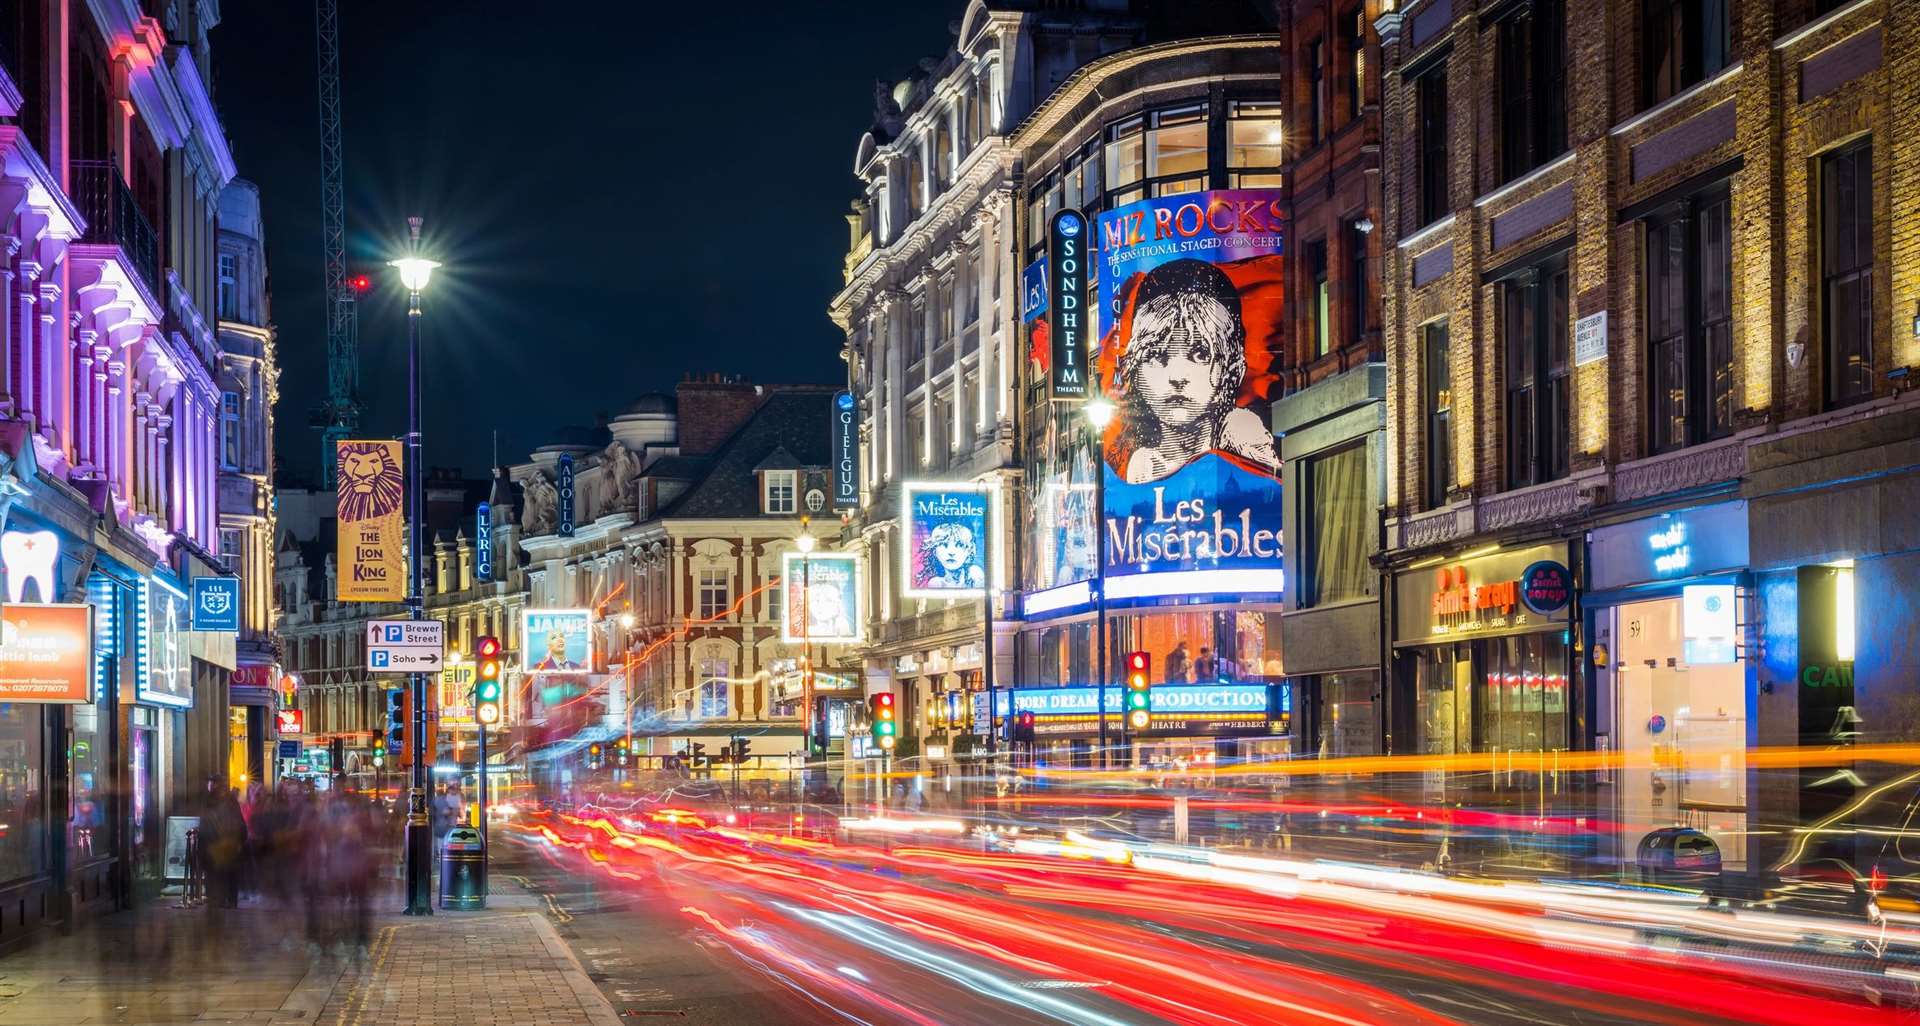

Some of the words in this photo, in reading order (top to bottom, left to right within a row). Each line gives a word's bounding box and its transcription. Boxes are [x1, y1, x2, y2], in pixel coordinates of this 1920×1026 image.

[1104, 211, 1145, 252] MIZ
[1120, 242, 1179, 263] SENSATIONAL
[1181, 237, 1221, 253] STAGED
[1223, 236, 1282, 250] CONCERT
[1062, 240, 1079, 383] SONDHEIM
[840, 412, 853, 496] GIELGUD
[561, 465, 572, 533] APOLLO
[941, 494, 958, 505] Les
[1153, 486, 1204, 524] Les
[919, 501, 984, 516] Misérables
[360, 532, 380, 542] THE
[480, 515, 490, 574] LYRIC
[405, 624, 439, 632] Brewer
[1631, 621, 1640, 638] 59
[445, 669, 453, 682] GET
[454, 667, 471, 682] UP
[1150, 692, 1266, 706] RODUCTION
[280, 723, 300, 733] LEON
